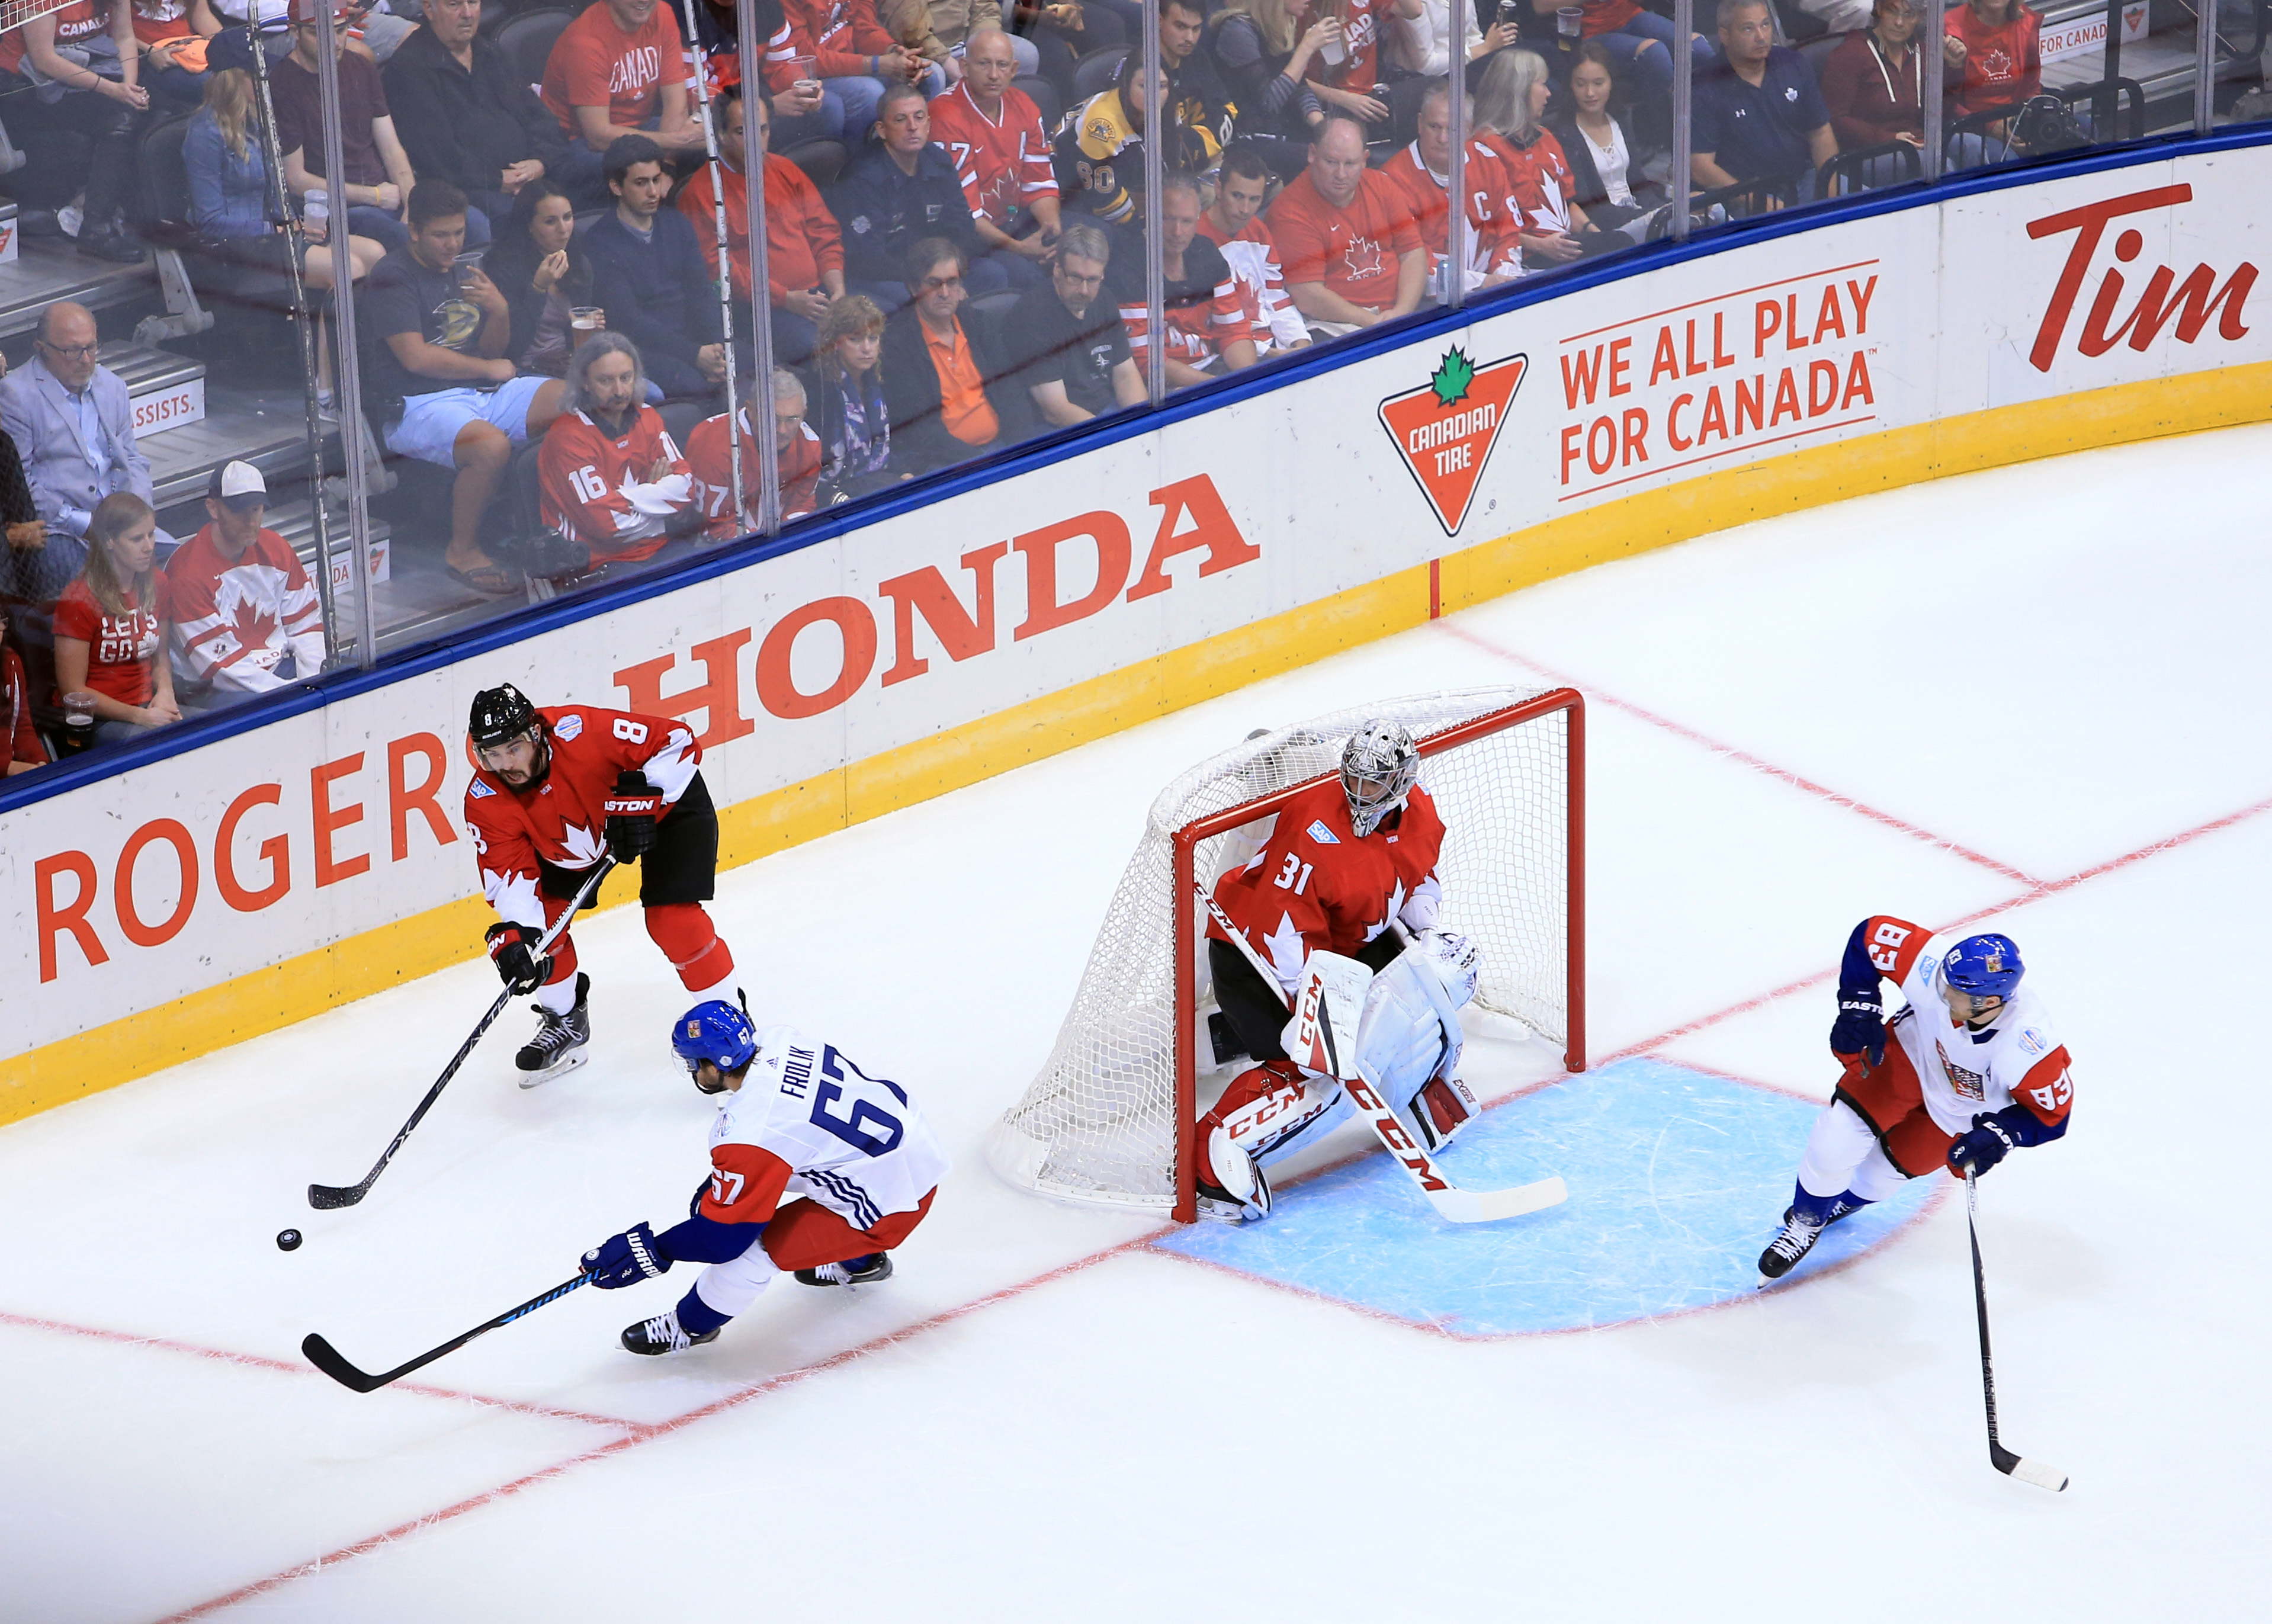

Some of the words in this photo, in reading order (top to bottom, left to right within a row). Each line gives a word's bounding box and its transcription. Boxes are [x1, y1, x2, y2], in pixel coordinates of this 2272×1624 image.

[2040, 36, 2063, 55] FOR
[2066, 24, 2107, 46] CANAD
[609, 46, 662, 93] CANAD
[1474, 191, 1492, 221] C
[2026, 182, 2260, 373] Tim
[1560, 335, 1633, 411] WE
[1649, 311, 1735, 388] ALL
[1754, 274, 1879, 360] PLAY
[131, 393, 195, 429] SSISTS.
[1409, 402, 1496, 455] CANADIAN
[1560, 406, 1650, 487] FOR
[1666, 349, 1875, 452] CANADA
[1434, 442, 1472, 477] TIRE
[568, 464, 608, 505] 16
[613, 473, 1260, 750] HONDA
[100, 638, 134, 663] GO
[482, 730, 502, 740] BAUER
[484, 713, 492, 726] 8
[612, 718, 649, 745] 8
[471, 782, 487, 796] SAP
[1311, 823, 1331, 842] SAP
[34, 730, 480, 984] ROGER
[1273, 851, 1315, 896] 31
[1194, 881, 1237, 930] CCM
[1249, 952, 1271, 979] PREMIER
[1867, 922, 1912, 971] 83
[1923, 955, 1936, 980] SAP
[1948, 948, 1963, 965] 83
[1300, 972, 1323, 1047] CCM
[1841, 1001, 1885, 1016] EASTO
[737, 1026, 750, 1045] 67
[779, 1045, 816, 1100] FROLIK
[2029, 1067, 2073, 1111] 83
[809, 1042, 908, 1158] 67
[1227, 1093, 1306, 1140] CCM
[1257, 1102, 1323, 1146] CCM
[1345, 1078, 1449, 1192] CCM
[1982, 1121, 2014, 1151] EAST
[1967, 1173, 1976, 1212] STEALTH
[626, 1232, 662, 1279] WARR
[1982, 1355, 2000, 1442] EASTON
